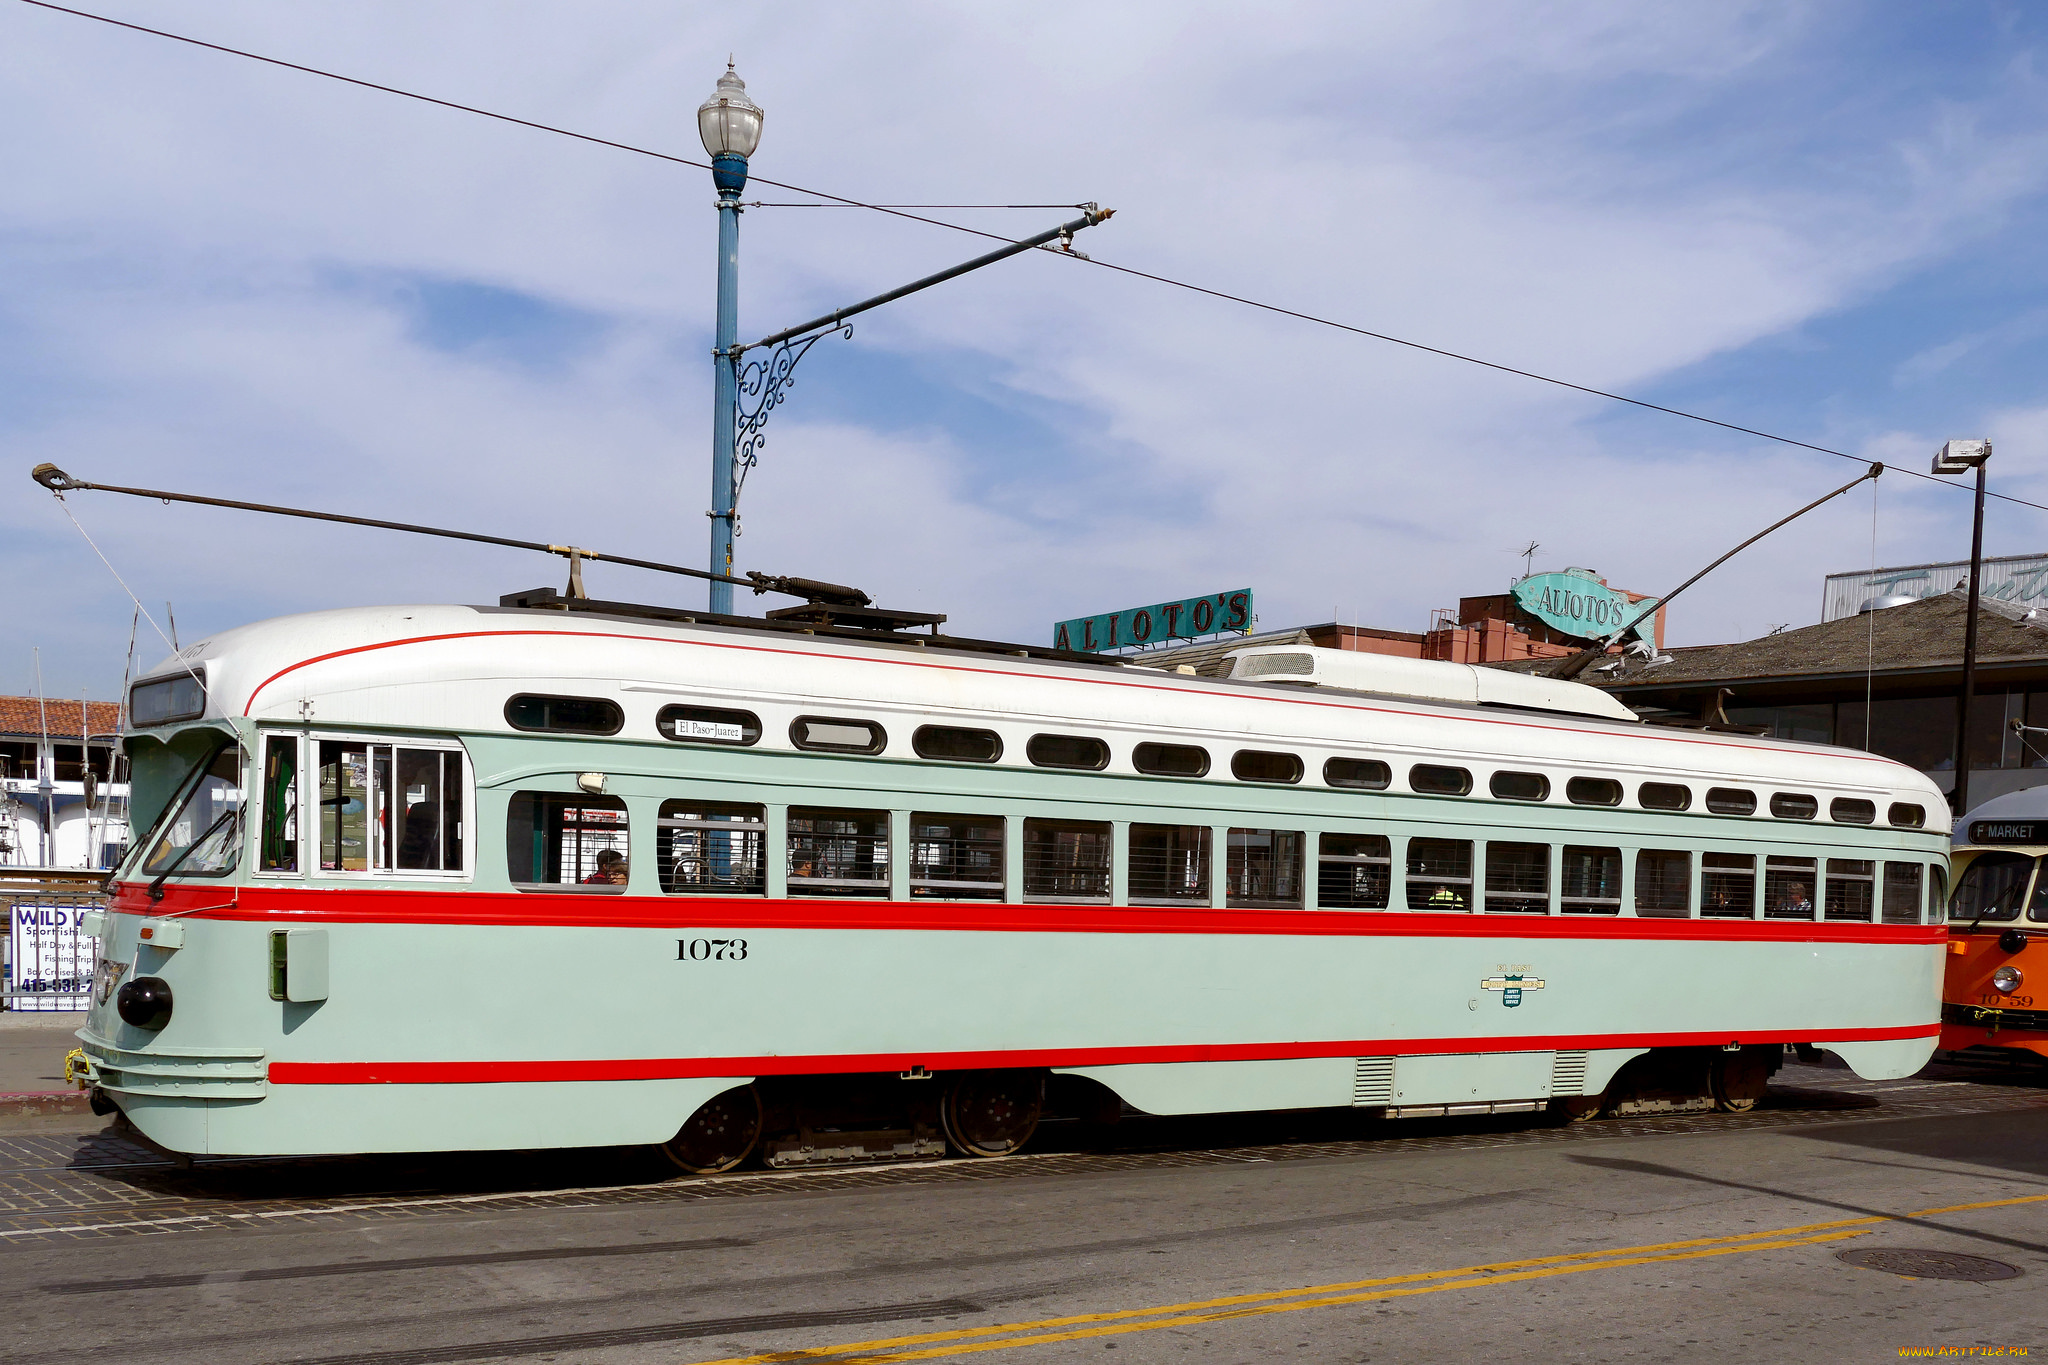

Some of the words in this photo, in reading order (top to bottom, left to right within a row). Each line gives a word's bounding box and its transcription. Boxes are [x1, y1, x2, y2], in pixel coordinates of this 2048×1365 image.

[1538, 585, 1624, 627] ALIOTO'S
[1056, 593, 1248, 651] ALIOTO'S
[680, 721, 689, 733] El
[692, 722, 739, 737] Paso-Juarez
[1977, 825, 1985, 837] F
[1988, 825, 2035, 838] MARKET
[19, 910, 68, 926] WILD
[674, 938, 748, 961] 1073
